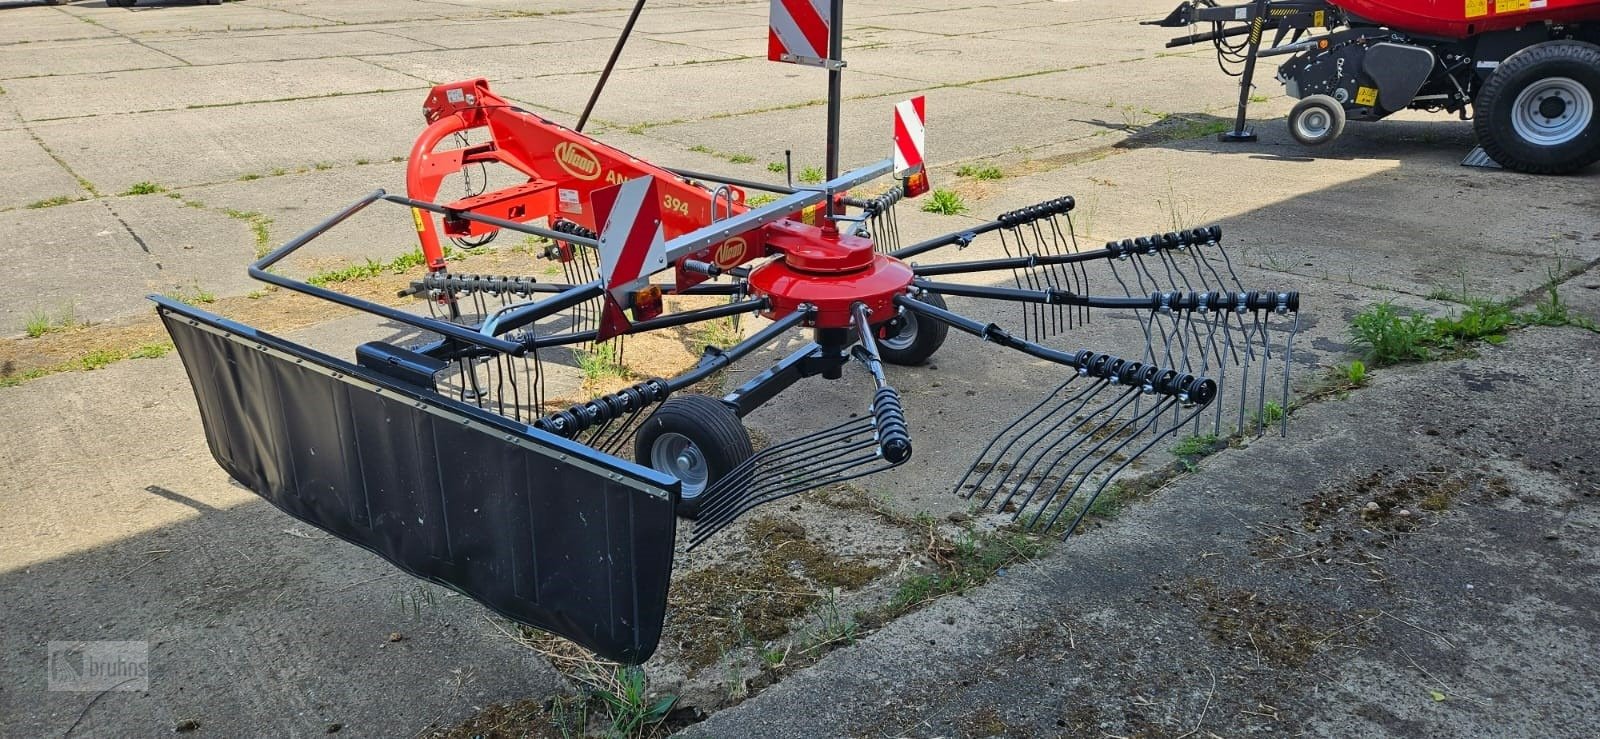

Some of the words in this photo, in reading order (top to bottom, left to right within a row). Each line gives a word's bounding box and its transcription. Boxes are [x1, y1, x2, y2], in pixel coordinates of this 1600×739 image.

[557, 142, 598, 175] Vicon
[605, 169, 628, 185] AN
[663, 194, 689, 216] 394
[718, 241, 744, 264] Vicon
